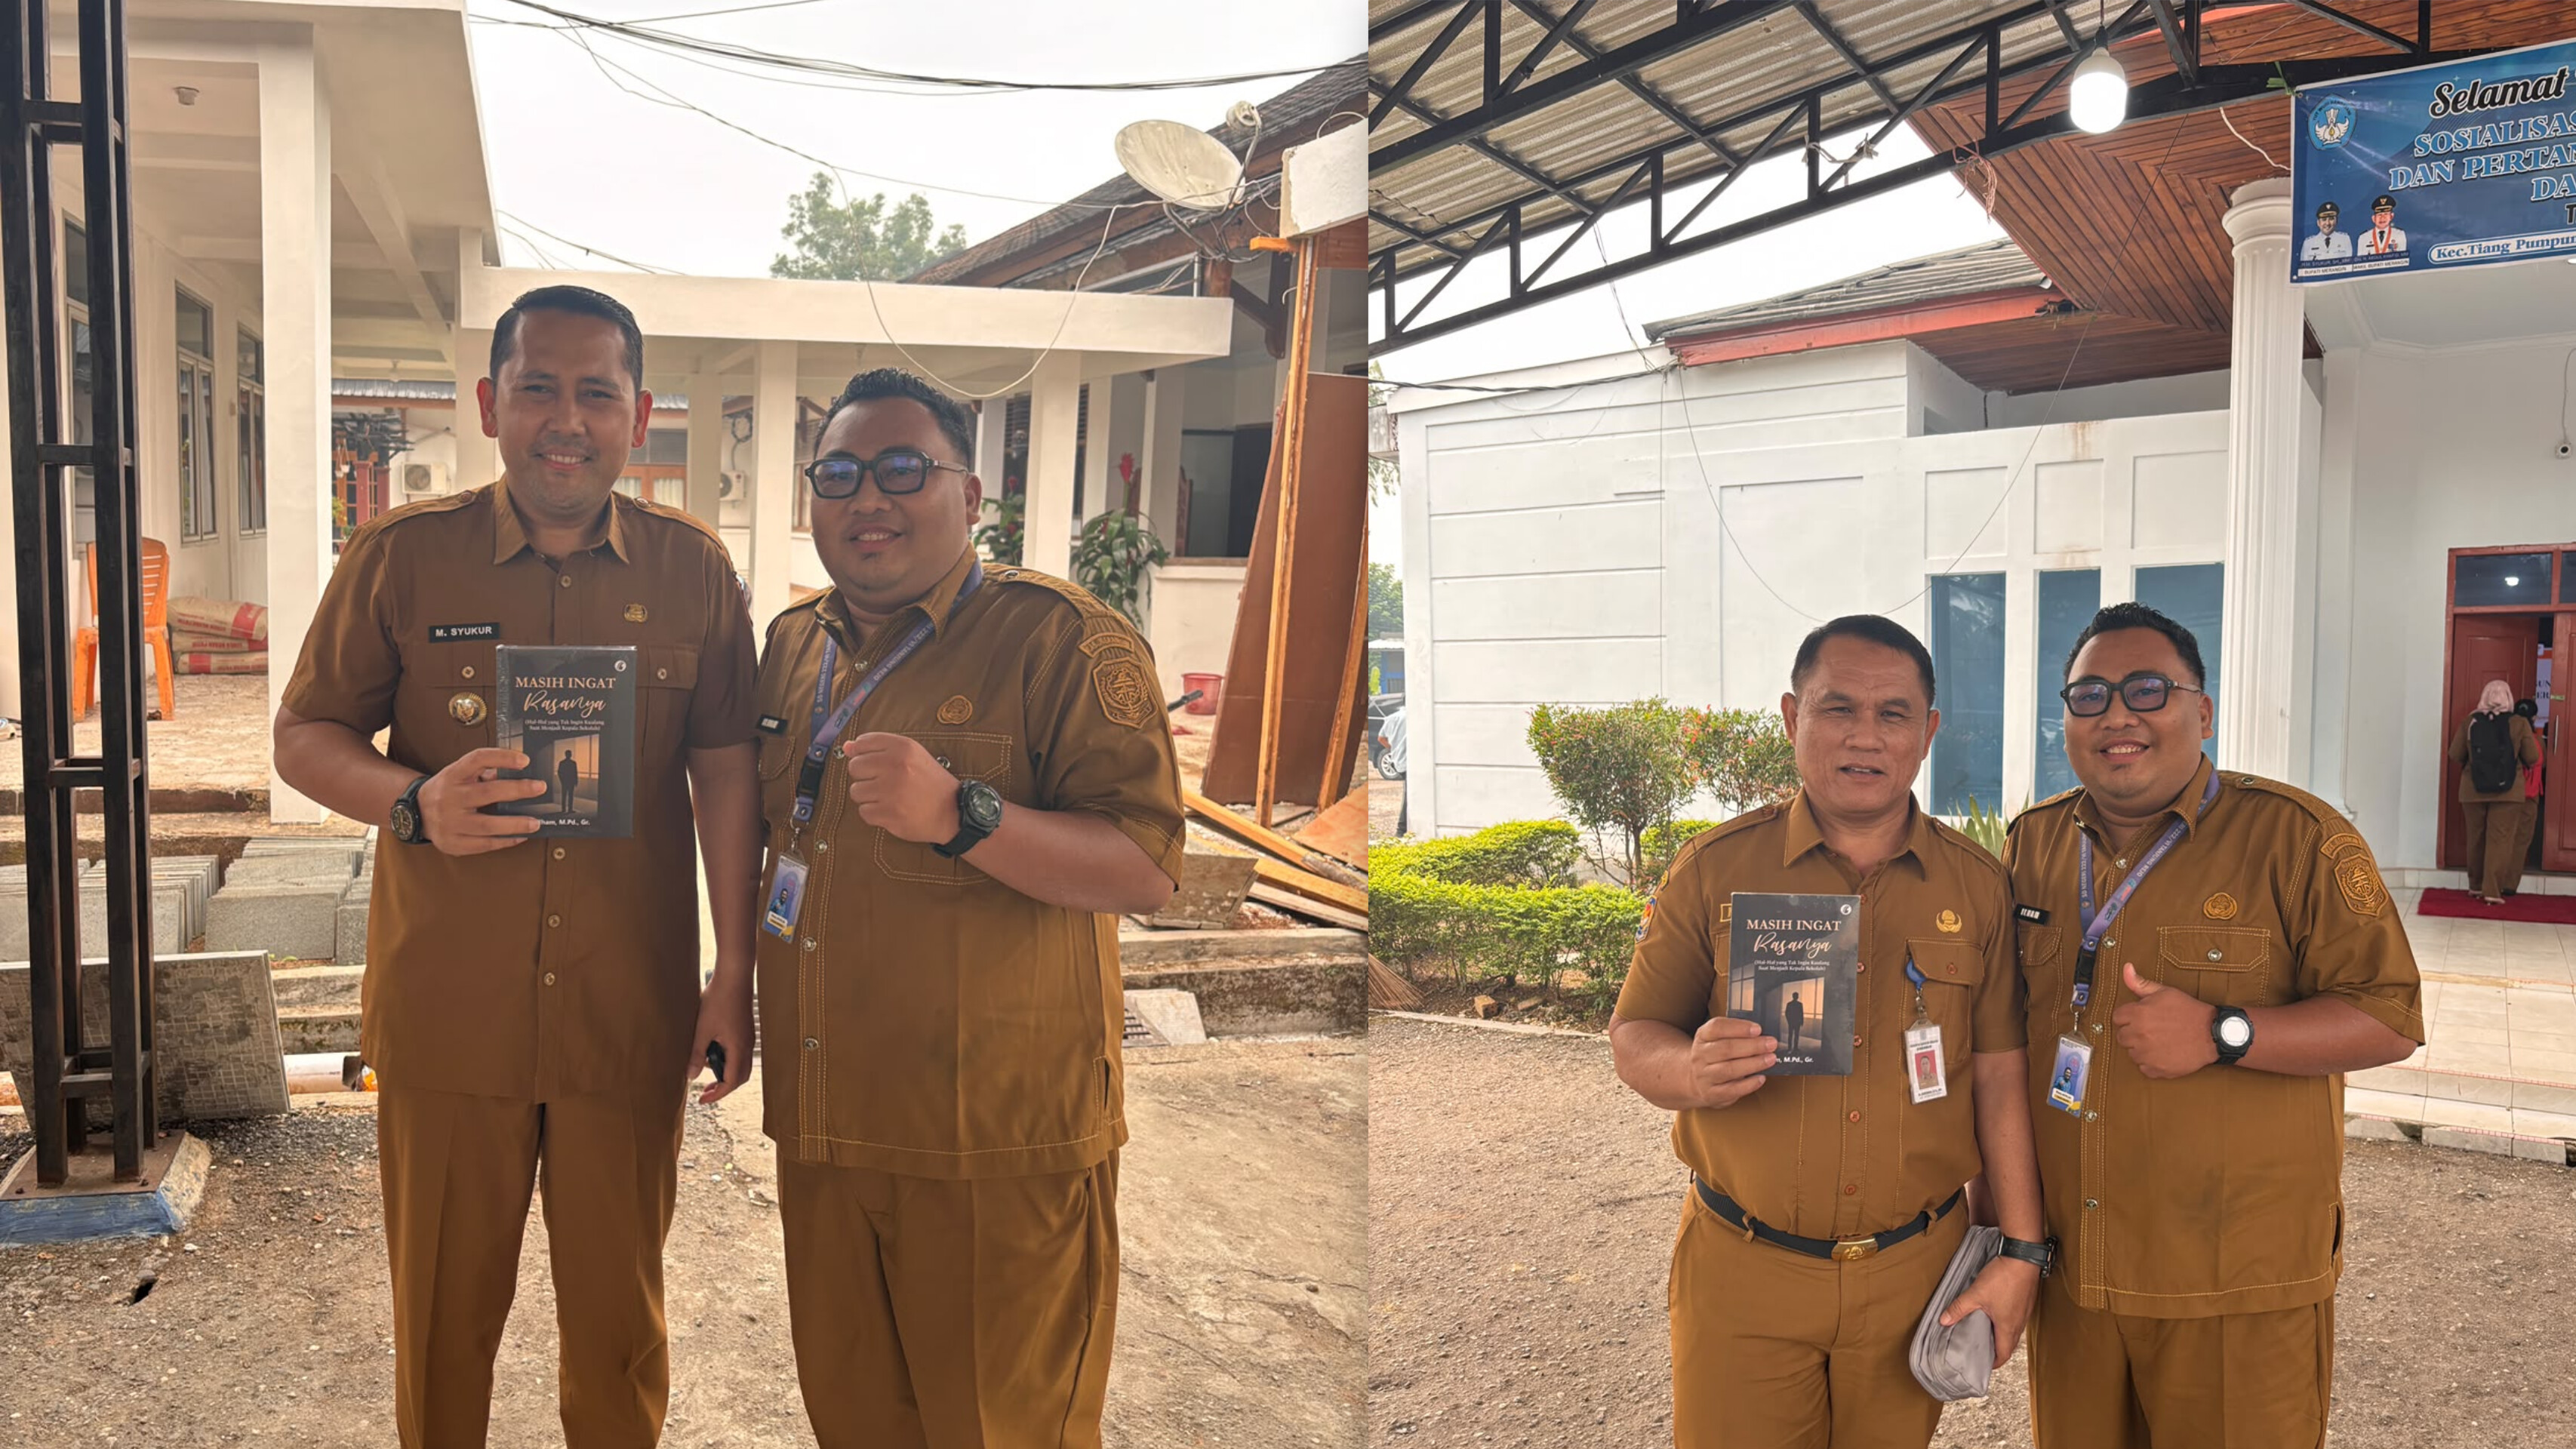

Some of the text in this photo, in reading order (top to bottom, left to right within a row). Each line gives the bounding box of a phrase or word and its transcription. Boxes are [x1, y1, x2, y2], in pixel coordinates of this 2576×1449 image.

[2429, 66, 2569, 118] Selamat
[2389, 159, 2455, 190] DAN
[435, 626, 492, 637] M. SYUKUR
[516, 676, 616, 689] MASIH INGAT
[524, 690, 606, 718] Rasanya
[1747, 919, 1842, 931] MASIH INGAT
[1753, 932, 1833, 959] Rasanya
